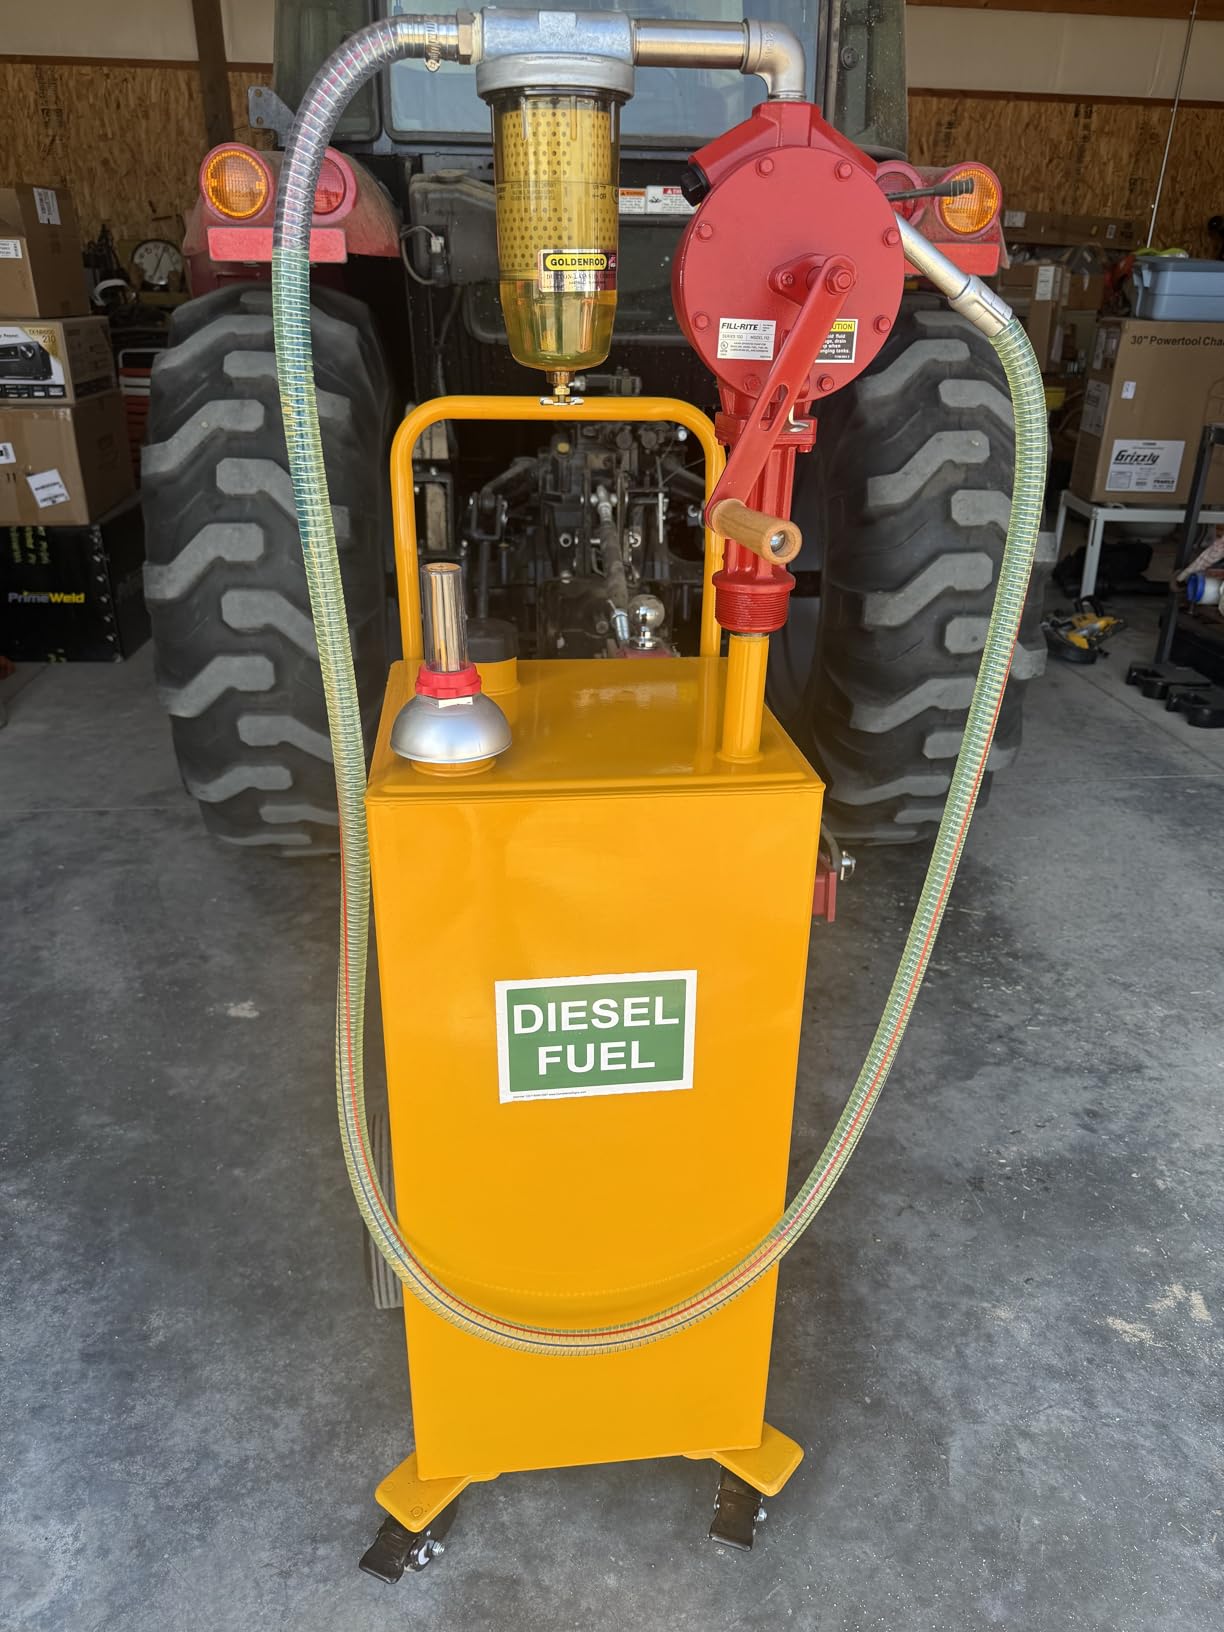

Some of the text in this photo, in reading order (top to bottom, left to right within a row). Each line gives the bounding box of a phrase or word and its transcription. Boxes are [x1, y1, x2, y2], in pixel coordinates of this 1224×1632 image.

[550, 258, 605, 266] GOLDENROD
[721, 322, 759, 331] FILL-RITE
[42, 335, 57, 344] 210
[1130, 335, 1224, 346] 30" Powertool Cha
[1114, 449, 1160, 465] Grizzly
[8, 592, 86, 603] PrimeWeld
[513, 996, 680, 1035] DIESEL
[537, 1040, 656, 1076] FUEL
